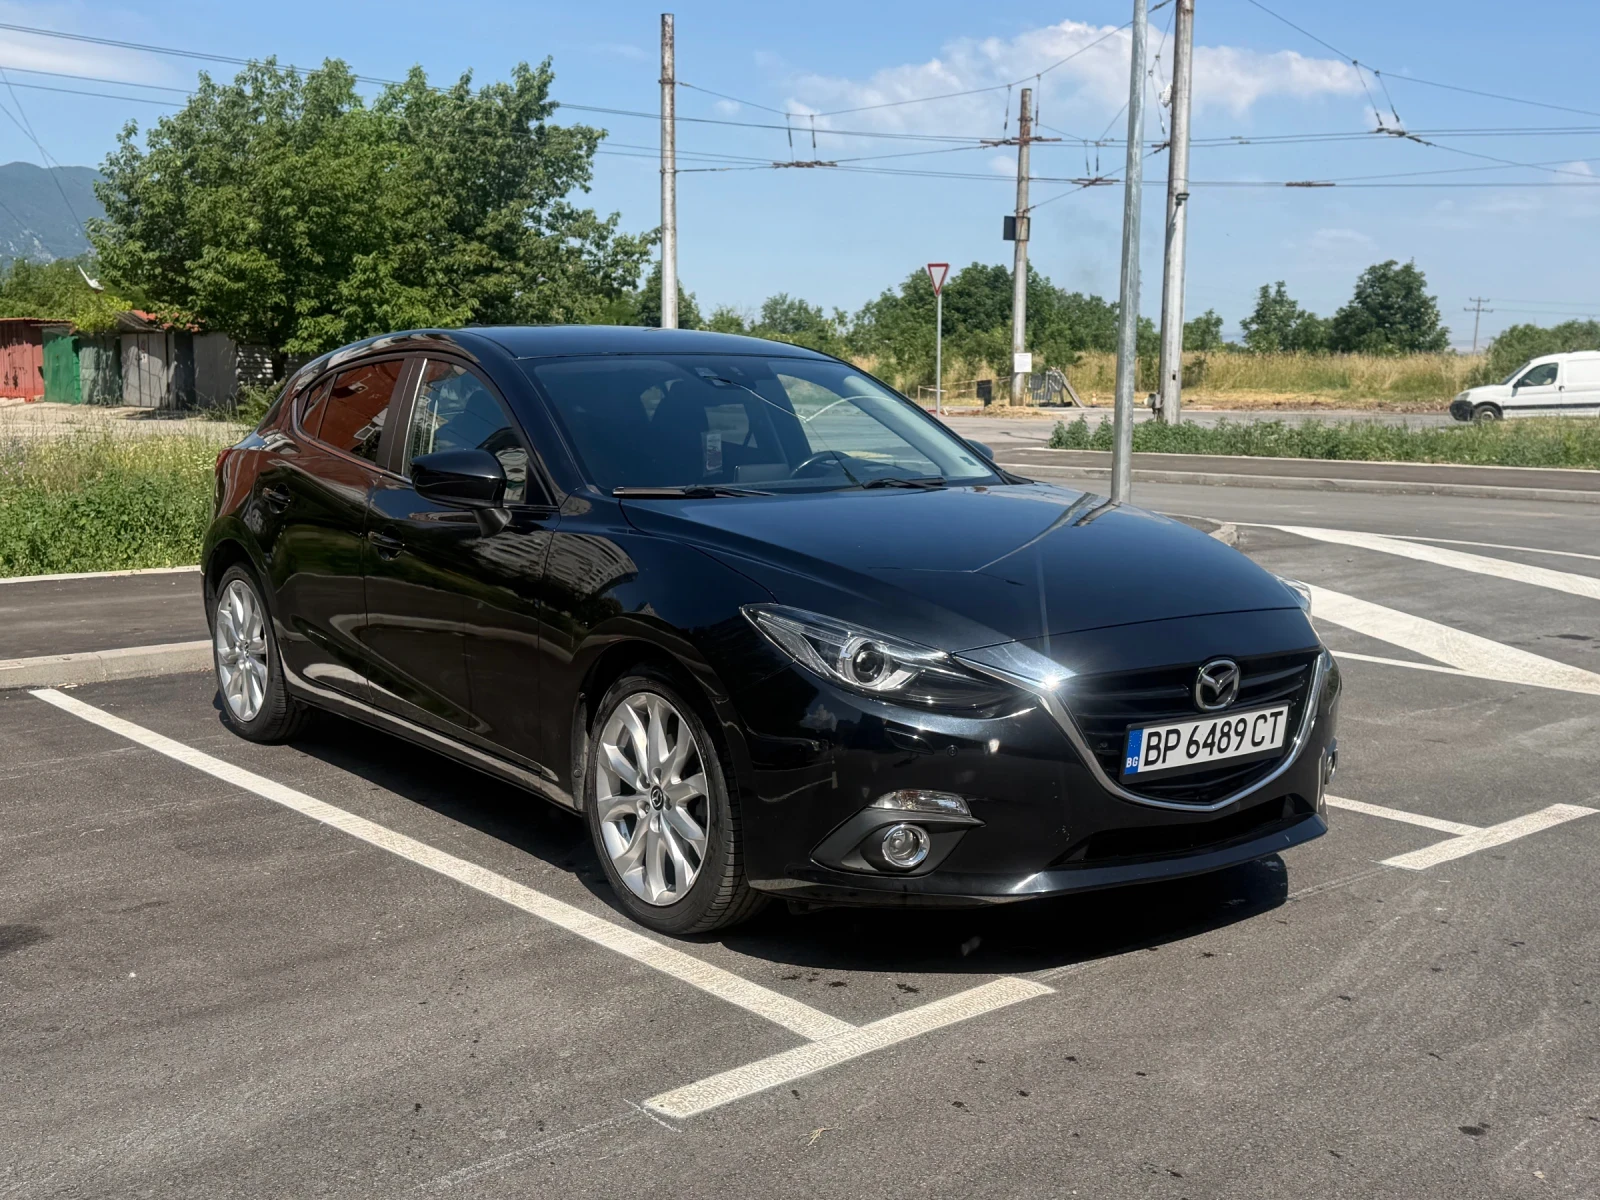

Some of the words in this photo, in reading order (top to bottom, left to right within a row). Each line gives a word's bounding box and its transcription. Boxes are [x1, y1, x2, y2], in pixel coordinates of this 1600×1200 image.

[1143, 728, 1181, 767] BP
[1186, 717, 1248, 759] 6489
[1251, 710, 1284, 747] CT
[1126, 756, 1139, 768] BG
